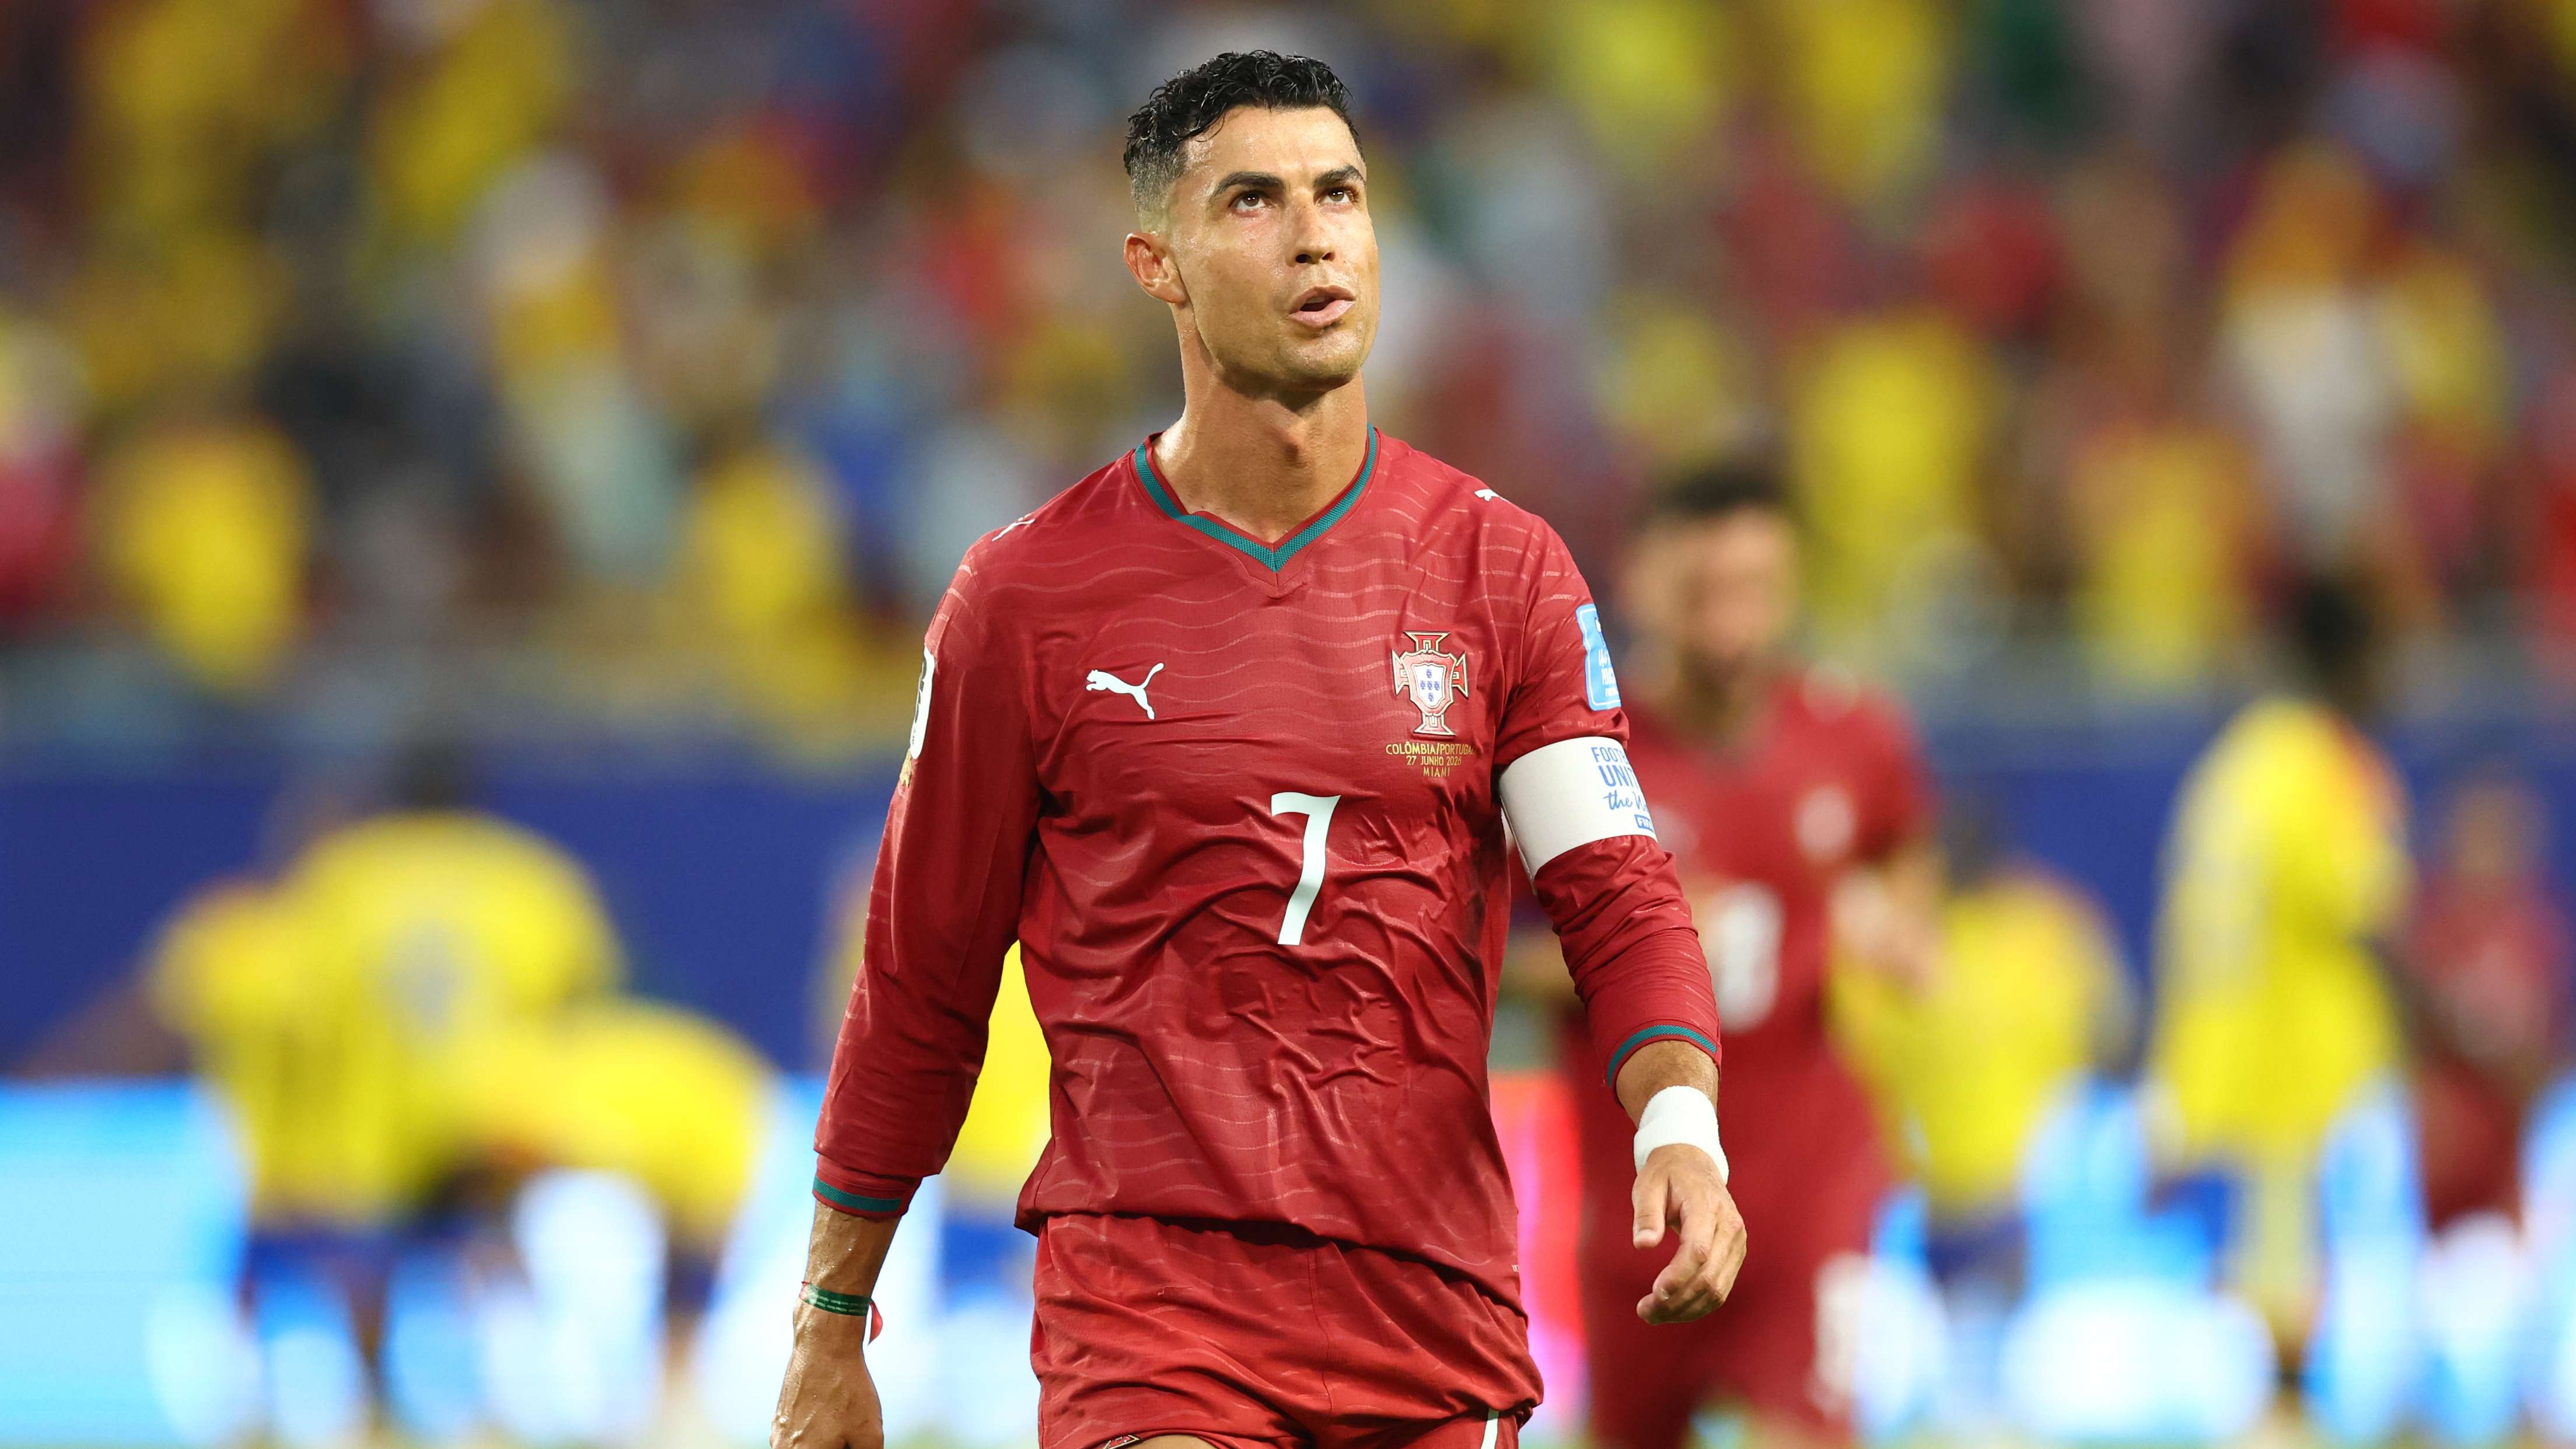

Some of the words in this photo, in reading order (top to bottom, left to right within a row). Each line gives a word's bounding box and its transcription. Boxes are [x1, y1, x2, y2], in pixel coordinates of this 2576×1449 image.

[1406, 755, 1417, 766] 27
[1420, 756, 1443, 766] JUNHO
[1446, 756, 1462, 766] 2026
[1423, 766, 1450, 778] MIAMI
[1603, 790, 1633, 811] the
[1271, 791, 1341, 946] 7
